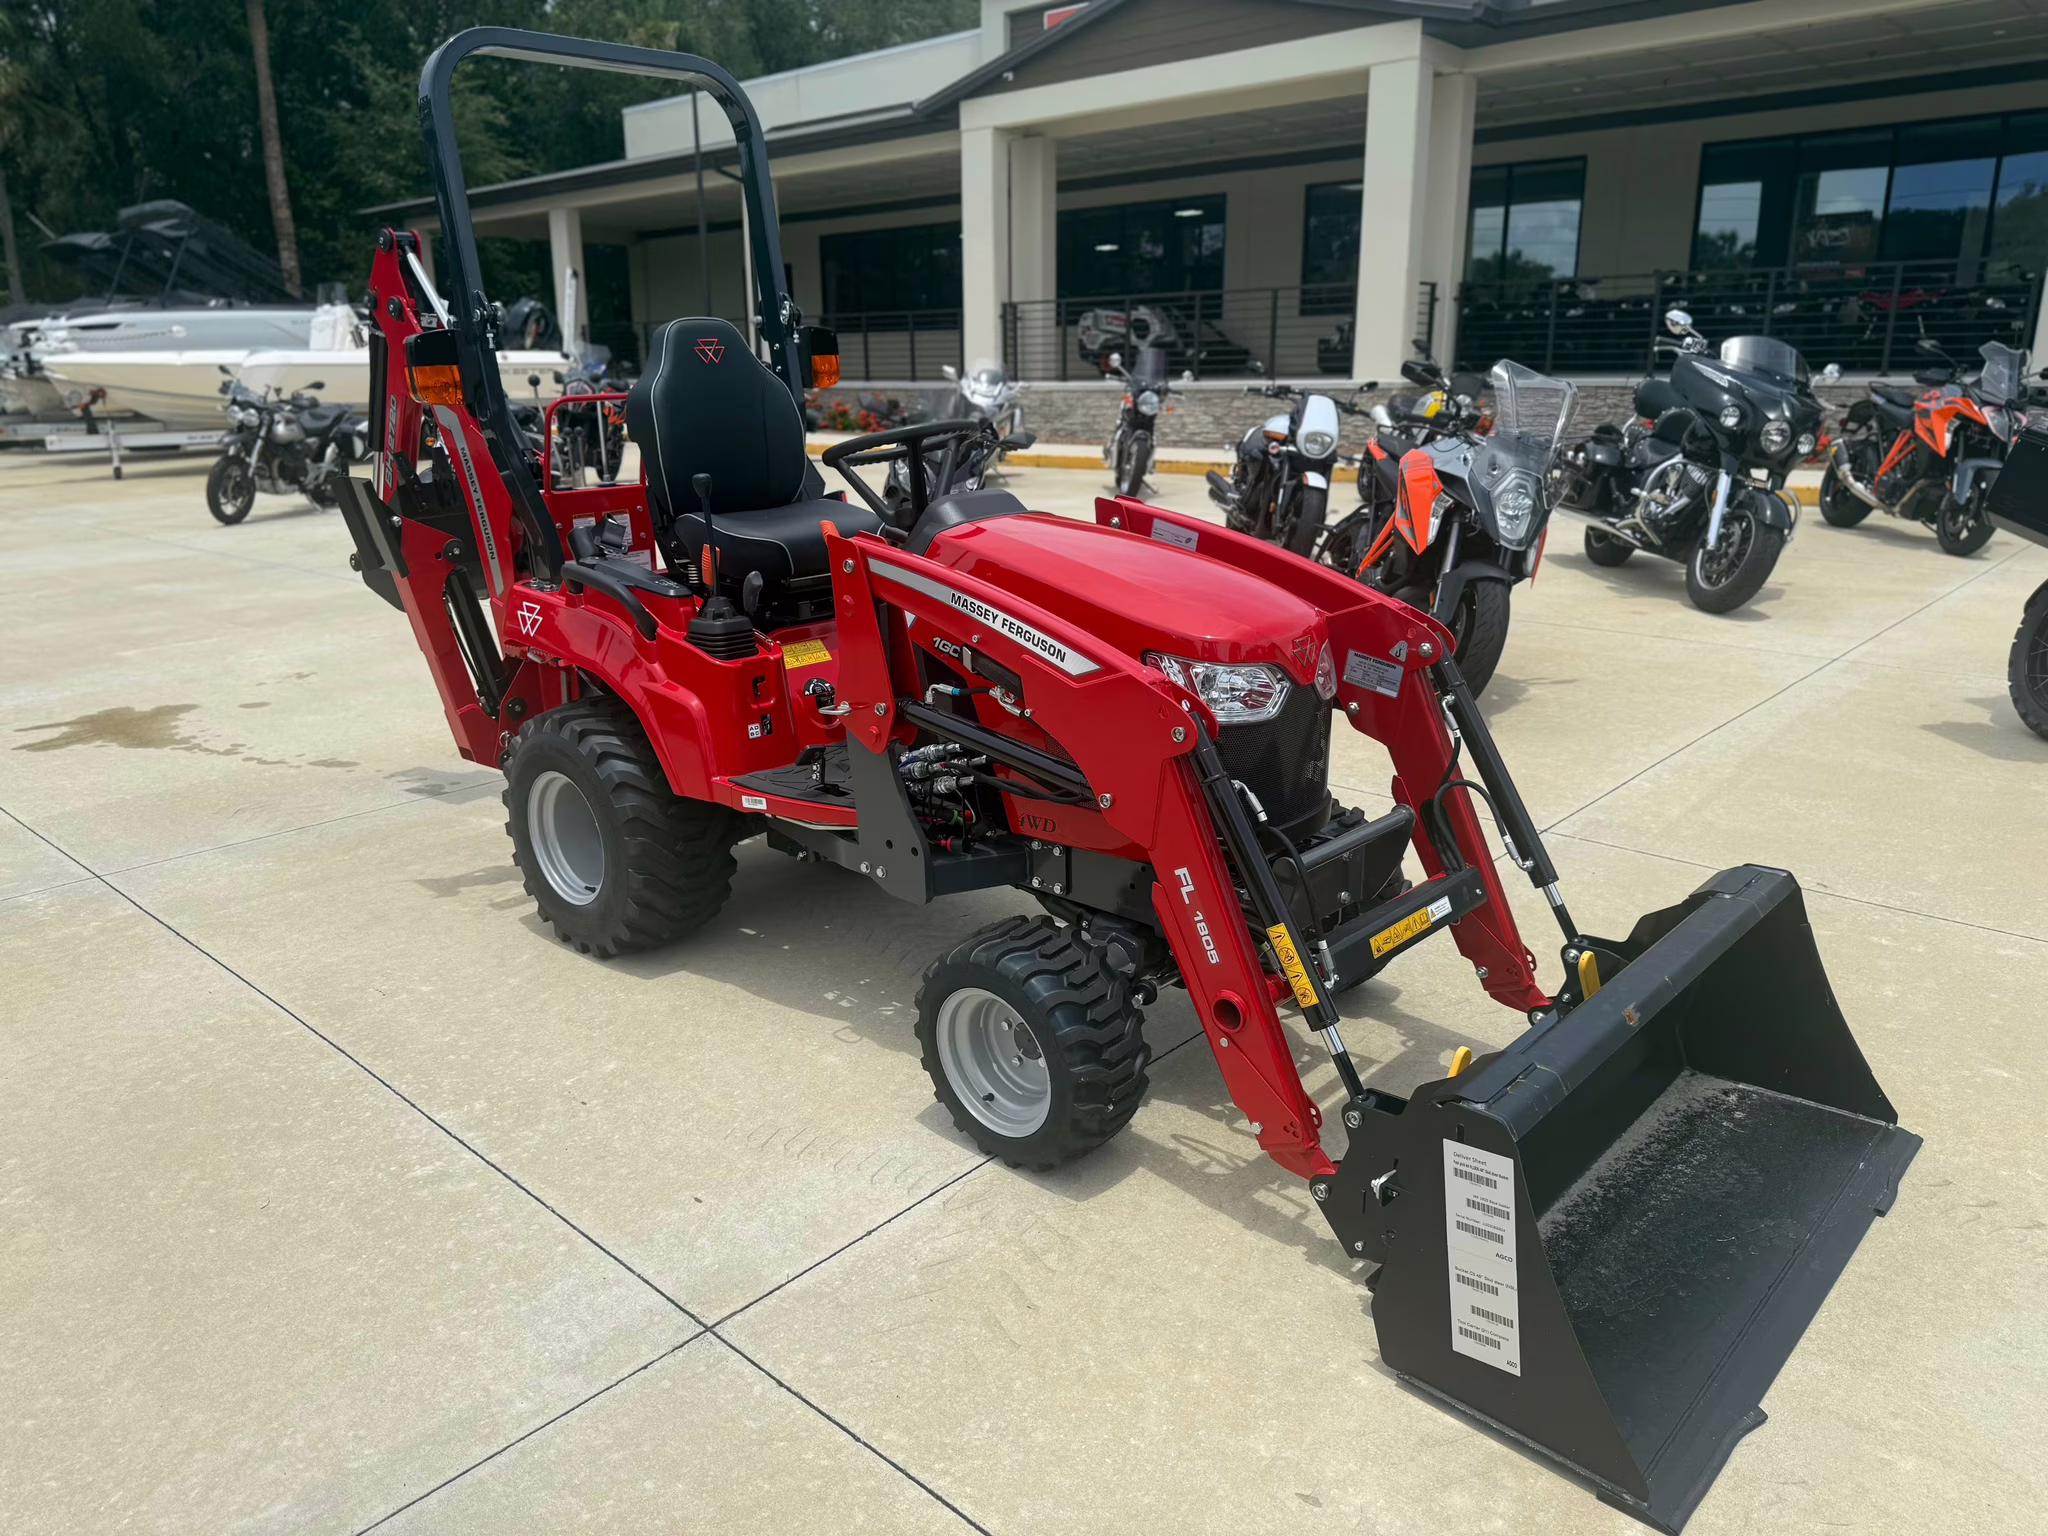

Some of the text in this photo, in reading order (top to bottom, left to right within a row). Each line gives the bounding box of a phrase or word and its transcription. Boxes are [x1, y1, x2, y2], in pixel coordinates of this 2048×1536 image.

[460, 446, 496, 560] MASSEY FERGUSON
[950, 592, 1067, 663] MASSEY FERGUSON
[1353, 652, 1372, 661] MASSEY
[1372, 658, 1397, 670] FERGUSON
[1018, 813, 1058, 833] 4WD
[1173, 866, 1220, 964] FL 1805
[1472, 1157, 1487, 1167] Sheet
[1495, 1252, 1513, 1263] AGCO
[1506, 1359, 1518, 1369] AGCO
